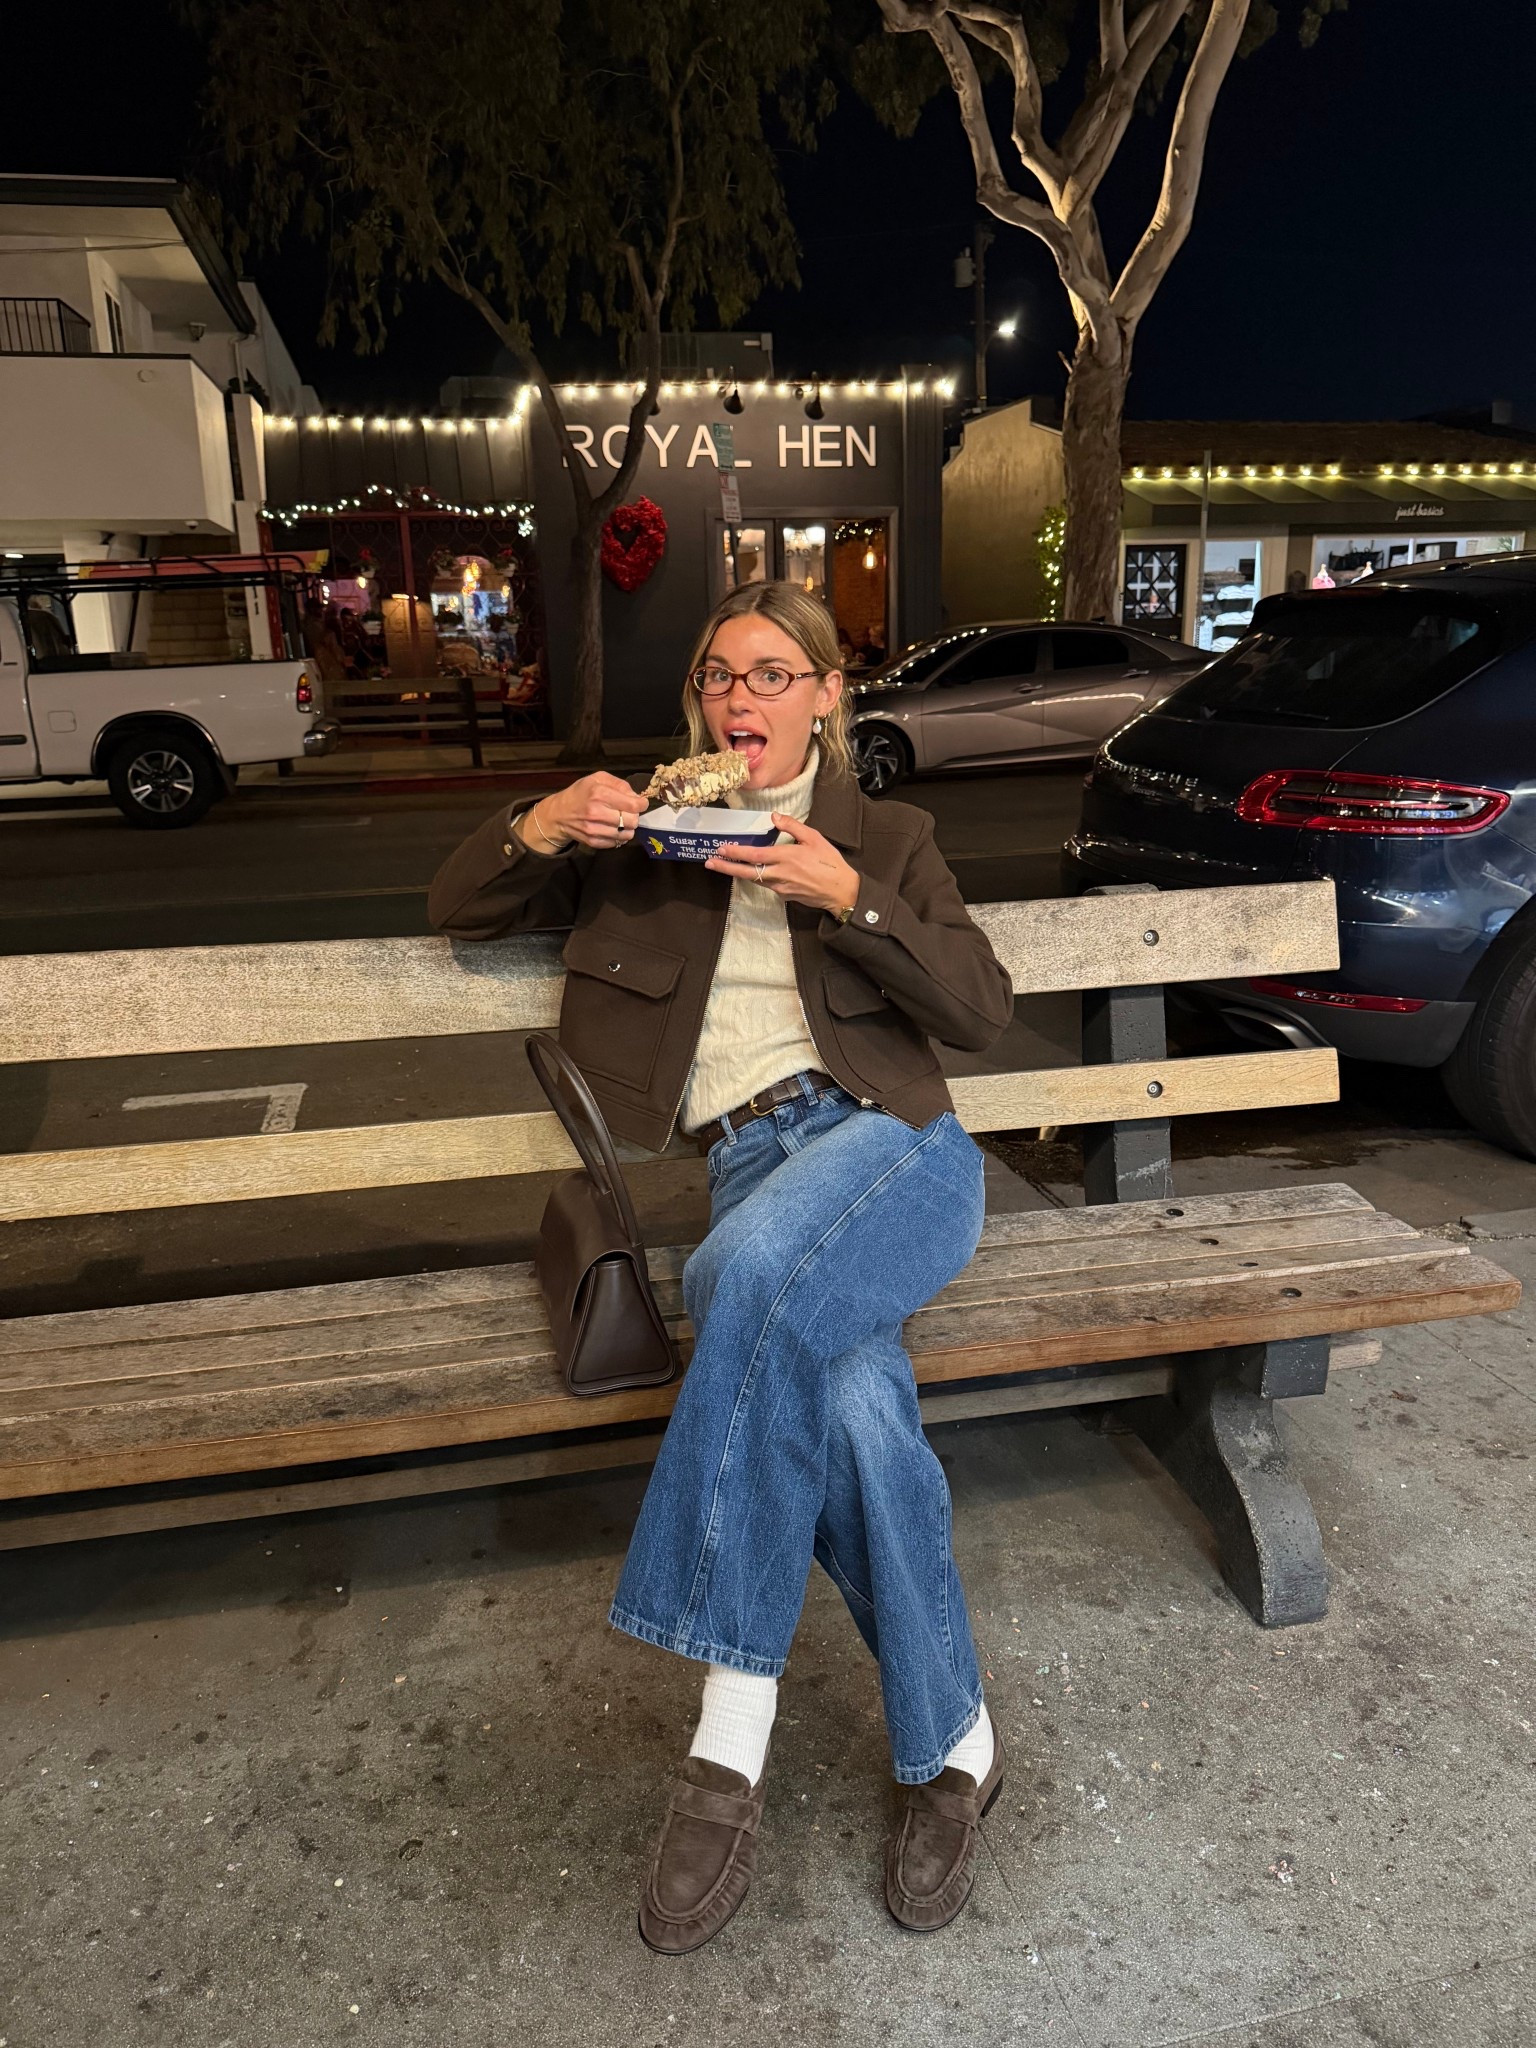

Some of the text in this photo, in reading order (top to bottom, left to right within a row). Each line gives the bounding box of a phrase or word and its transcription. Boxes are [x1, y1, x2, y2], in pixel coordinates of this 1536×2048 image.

[777, 423, 878, 468] HEN
[1394, 503, 1417, 521] just
[668, 836, 698, 846] Sugar
[677, 851, 707, 860] FROZEN
